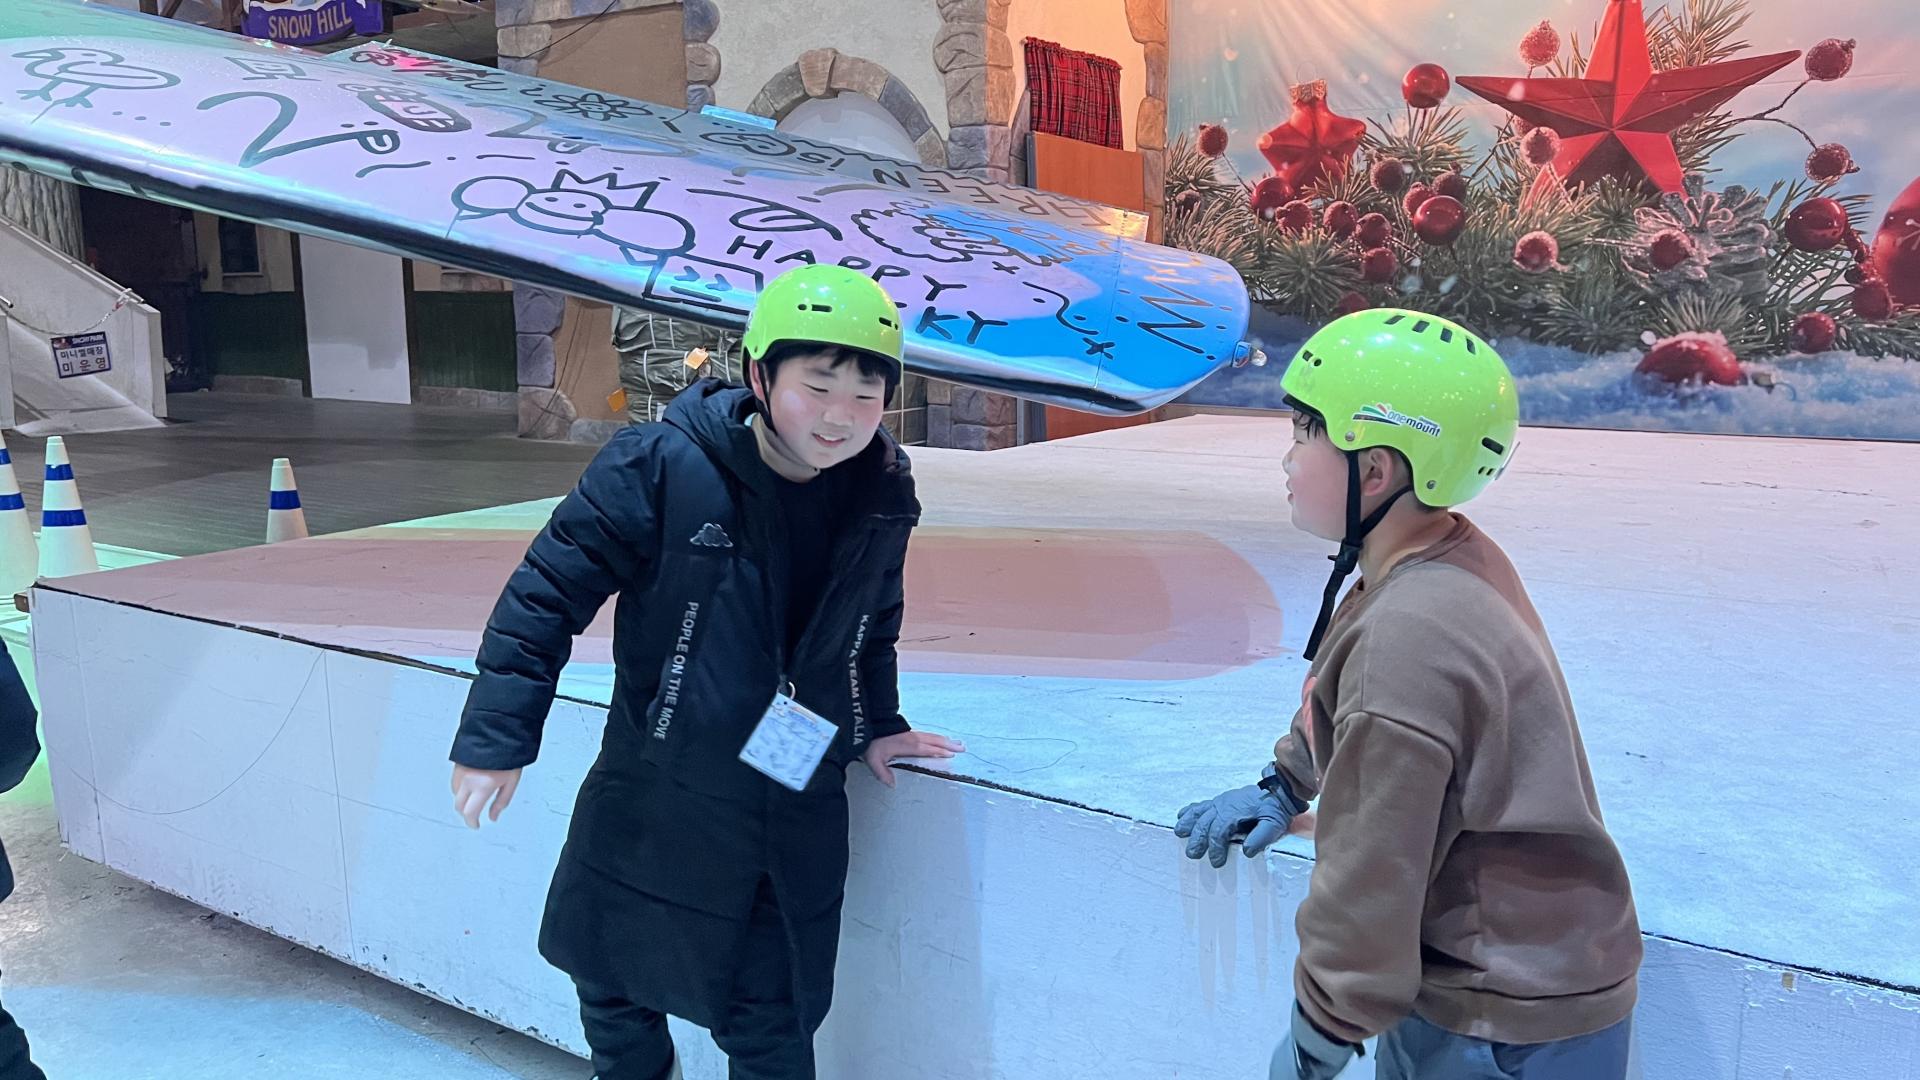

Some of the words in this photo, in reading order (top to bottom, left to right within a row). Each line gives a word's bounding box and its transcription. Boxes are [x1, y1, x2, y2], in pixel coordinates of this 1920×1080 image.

[267, 15, 312, 39] SNOW
[316, 2, 352, 35] HILL
[726, 235, 967, 301] HAPPY
[675, 601, 699, 653] PEOPLE
[849, 614, 869, 658] KAPPA
[671, 654, 686, 674] ON
[849, 660, 860, 698] TEAM
[664, 678, 682, 705] THE
[653, 707, 674, 739] MOVE
[853, 702, 865, 746] ITALIA
